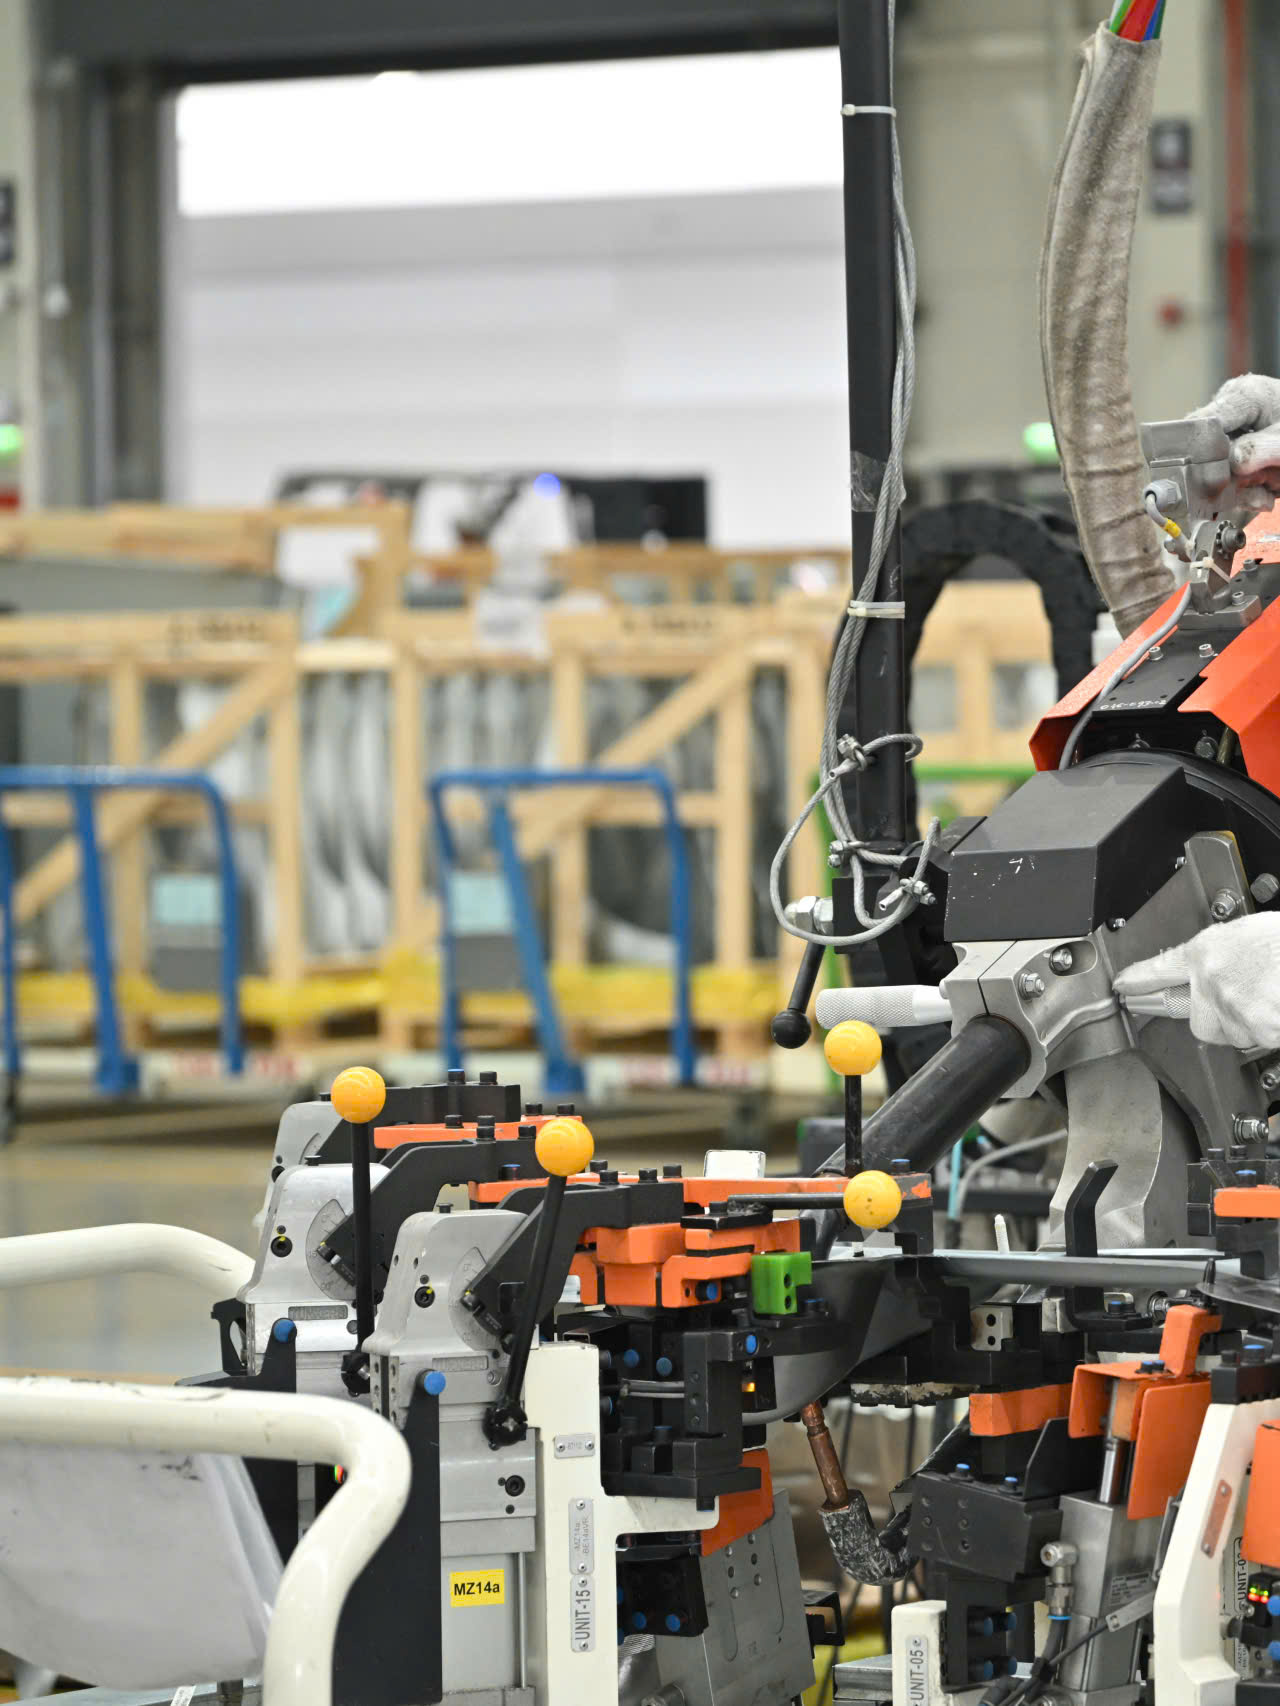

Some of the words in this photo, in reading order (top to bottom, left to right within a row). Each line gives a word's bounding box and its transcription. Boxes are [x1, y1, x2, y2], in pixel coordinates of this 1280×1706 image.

[453, 1581, 501, 1596] MZ14a
[575, 1589, 591, 1641] UNIT-15
[909, 1649, 925, 1701] UNIT-05
